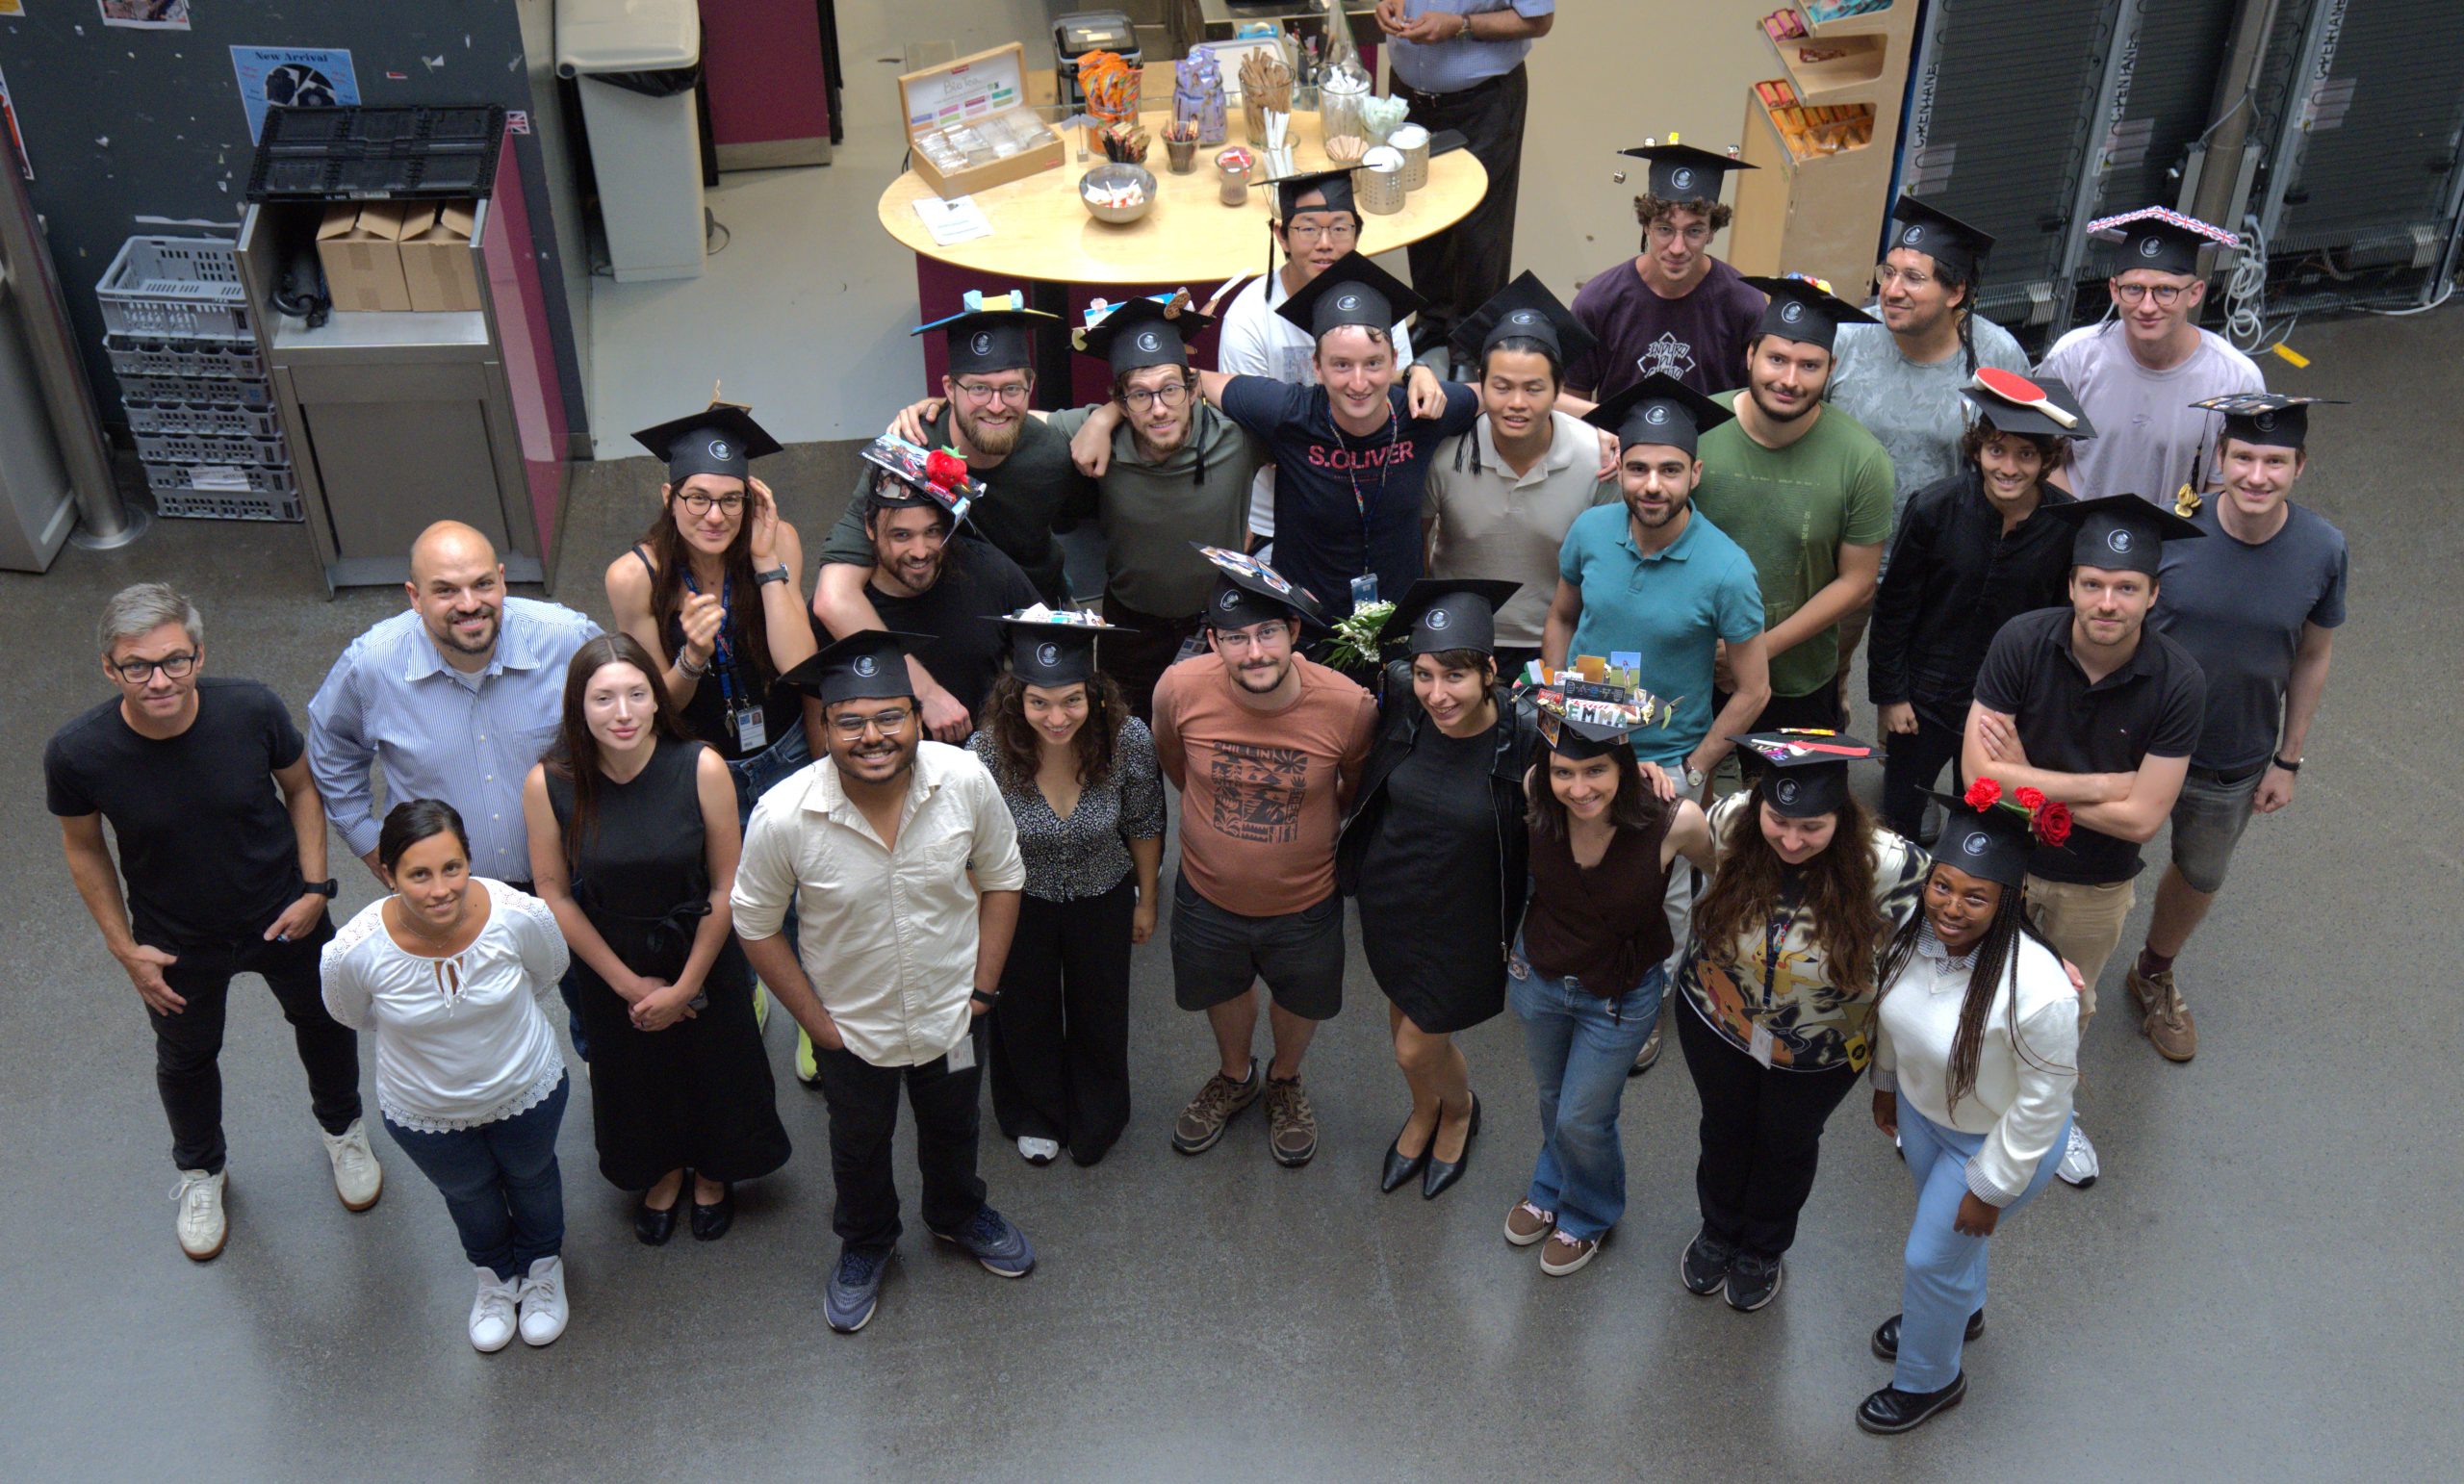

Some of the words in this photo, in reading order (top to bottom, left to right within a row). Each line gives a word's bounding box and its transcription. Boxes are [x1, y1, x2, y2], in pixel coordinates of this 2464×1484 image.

[255, 51, 282, 62] New
[284, 52, 328, 63] Arrival
[1309, 441, 1414, 470] S.OLIVER
[1566, 703, 1628, 729] EMMA
